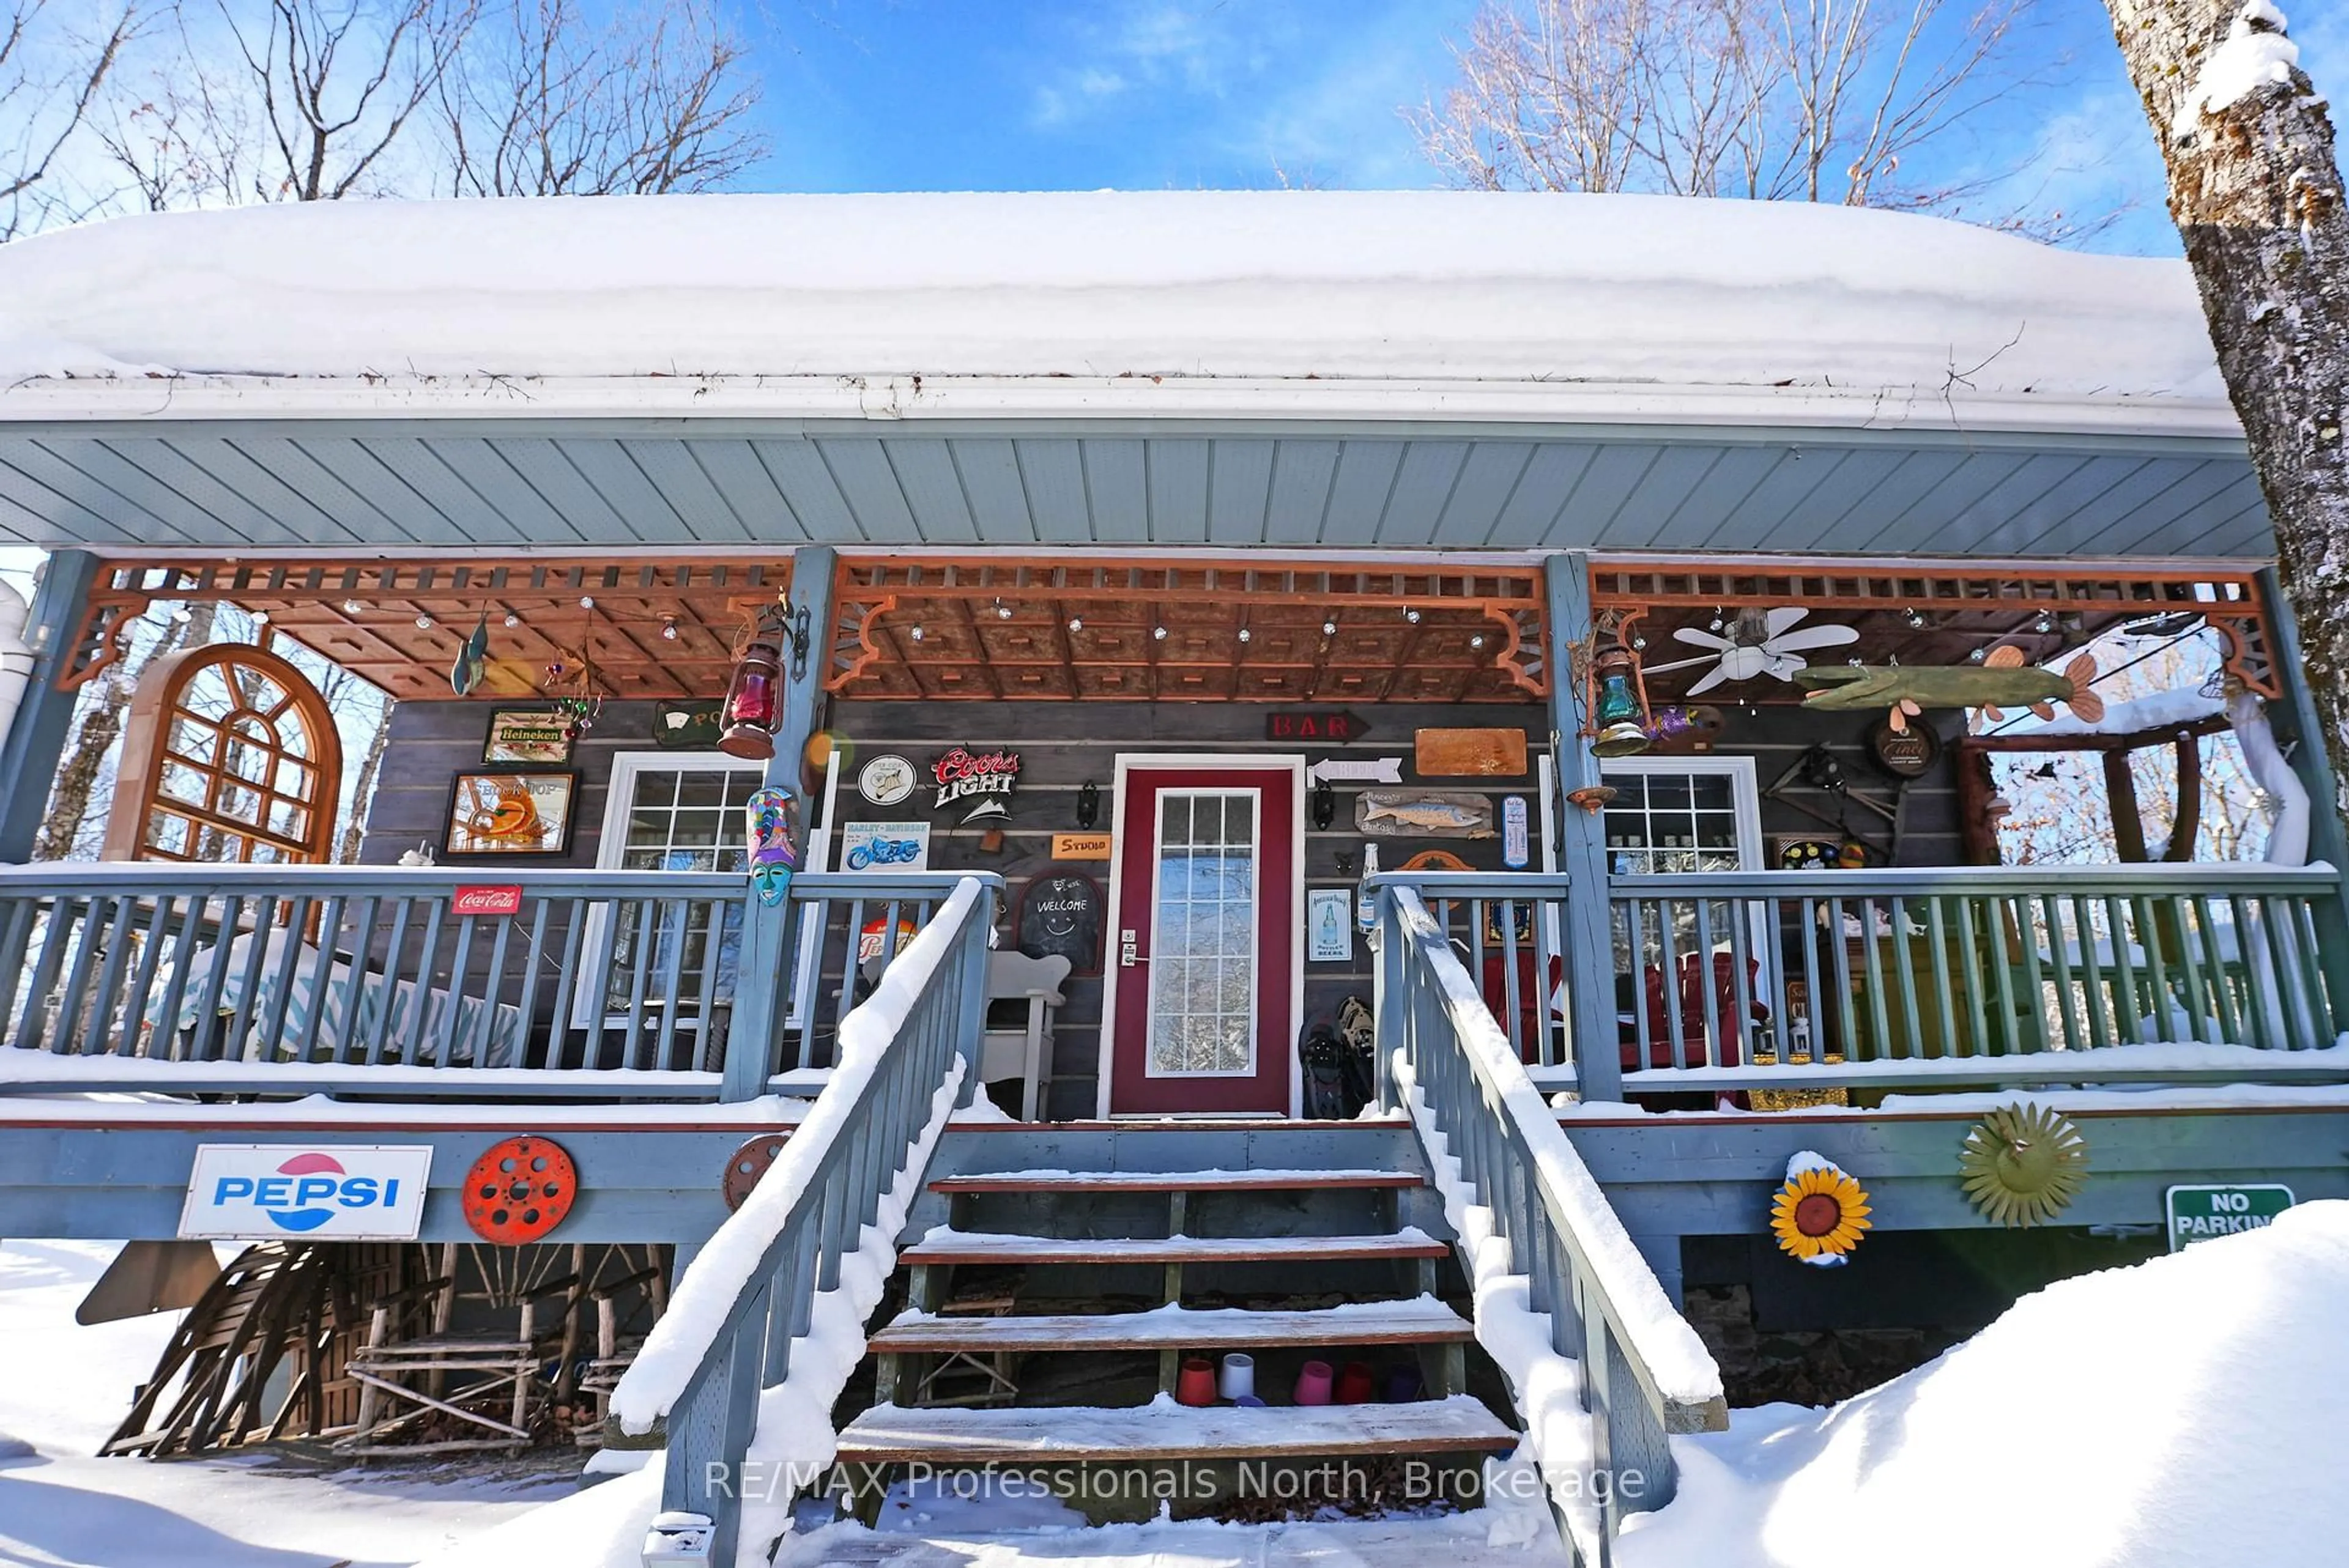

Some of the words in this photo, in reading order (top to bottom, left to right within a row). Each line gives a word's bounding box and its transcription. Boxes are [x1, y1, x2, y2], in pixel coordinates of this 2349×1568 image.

[502, 729, 558, 740] Heineken
[1274, 715, 1348, 738] BAR
[931, 747, 1019, 785] Coors
[933, 773, 1015, 808] LIGHT
[1037, 900, 1088, 912] WELCOME
[213, 1177, 399, 1207] PEPSI
[2211, 1193, 2250, 1212] NO
[2176, 1215, 2273, 1234] PARKIN
